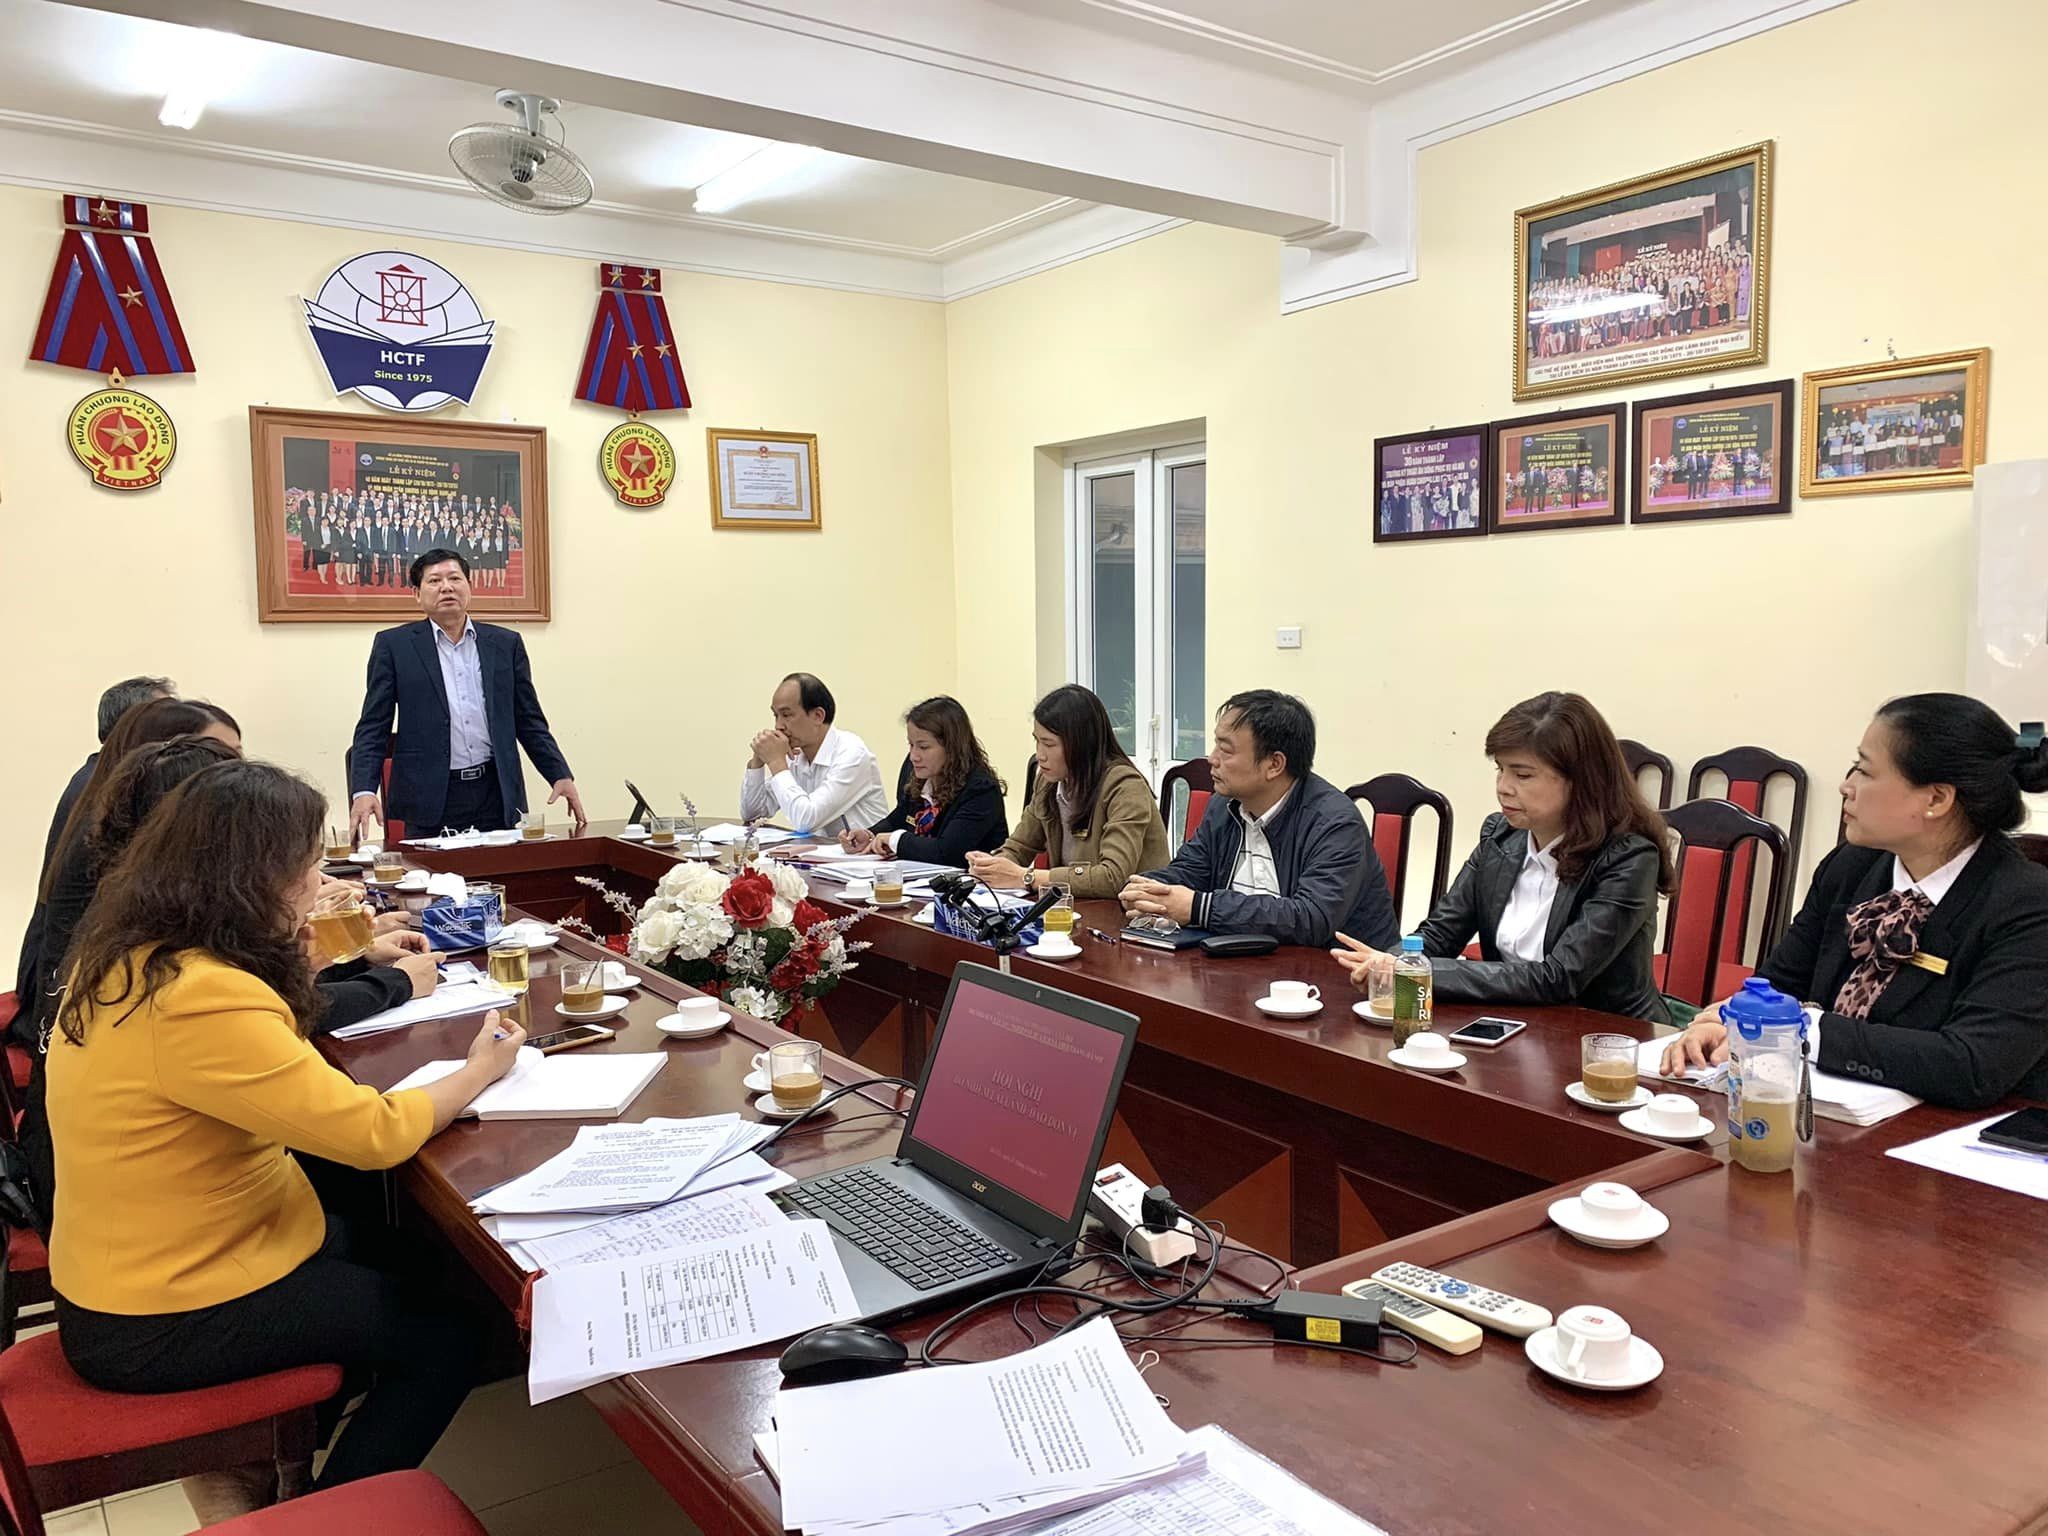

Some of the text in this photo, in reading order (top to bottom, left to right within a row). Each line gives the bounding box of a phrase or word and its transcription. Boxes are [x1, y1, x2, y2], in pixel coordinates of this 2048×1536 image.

[381, 350, 426, 367] HCTF
[374, 369, 433, 383] Since 1975
[133, 399, 154, 415] LAO
[645, 431, 661, 444] LAO
[103, 475, 153, 487] VIETNAM
[972, 1181, 987, 1192] acer
